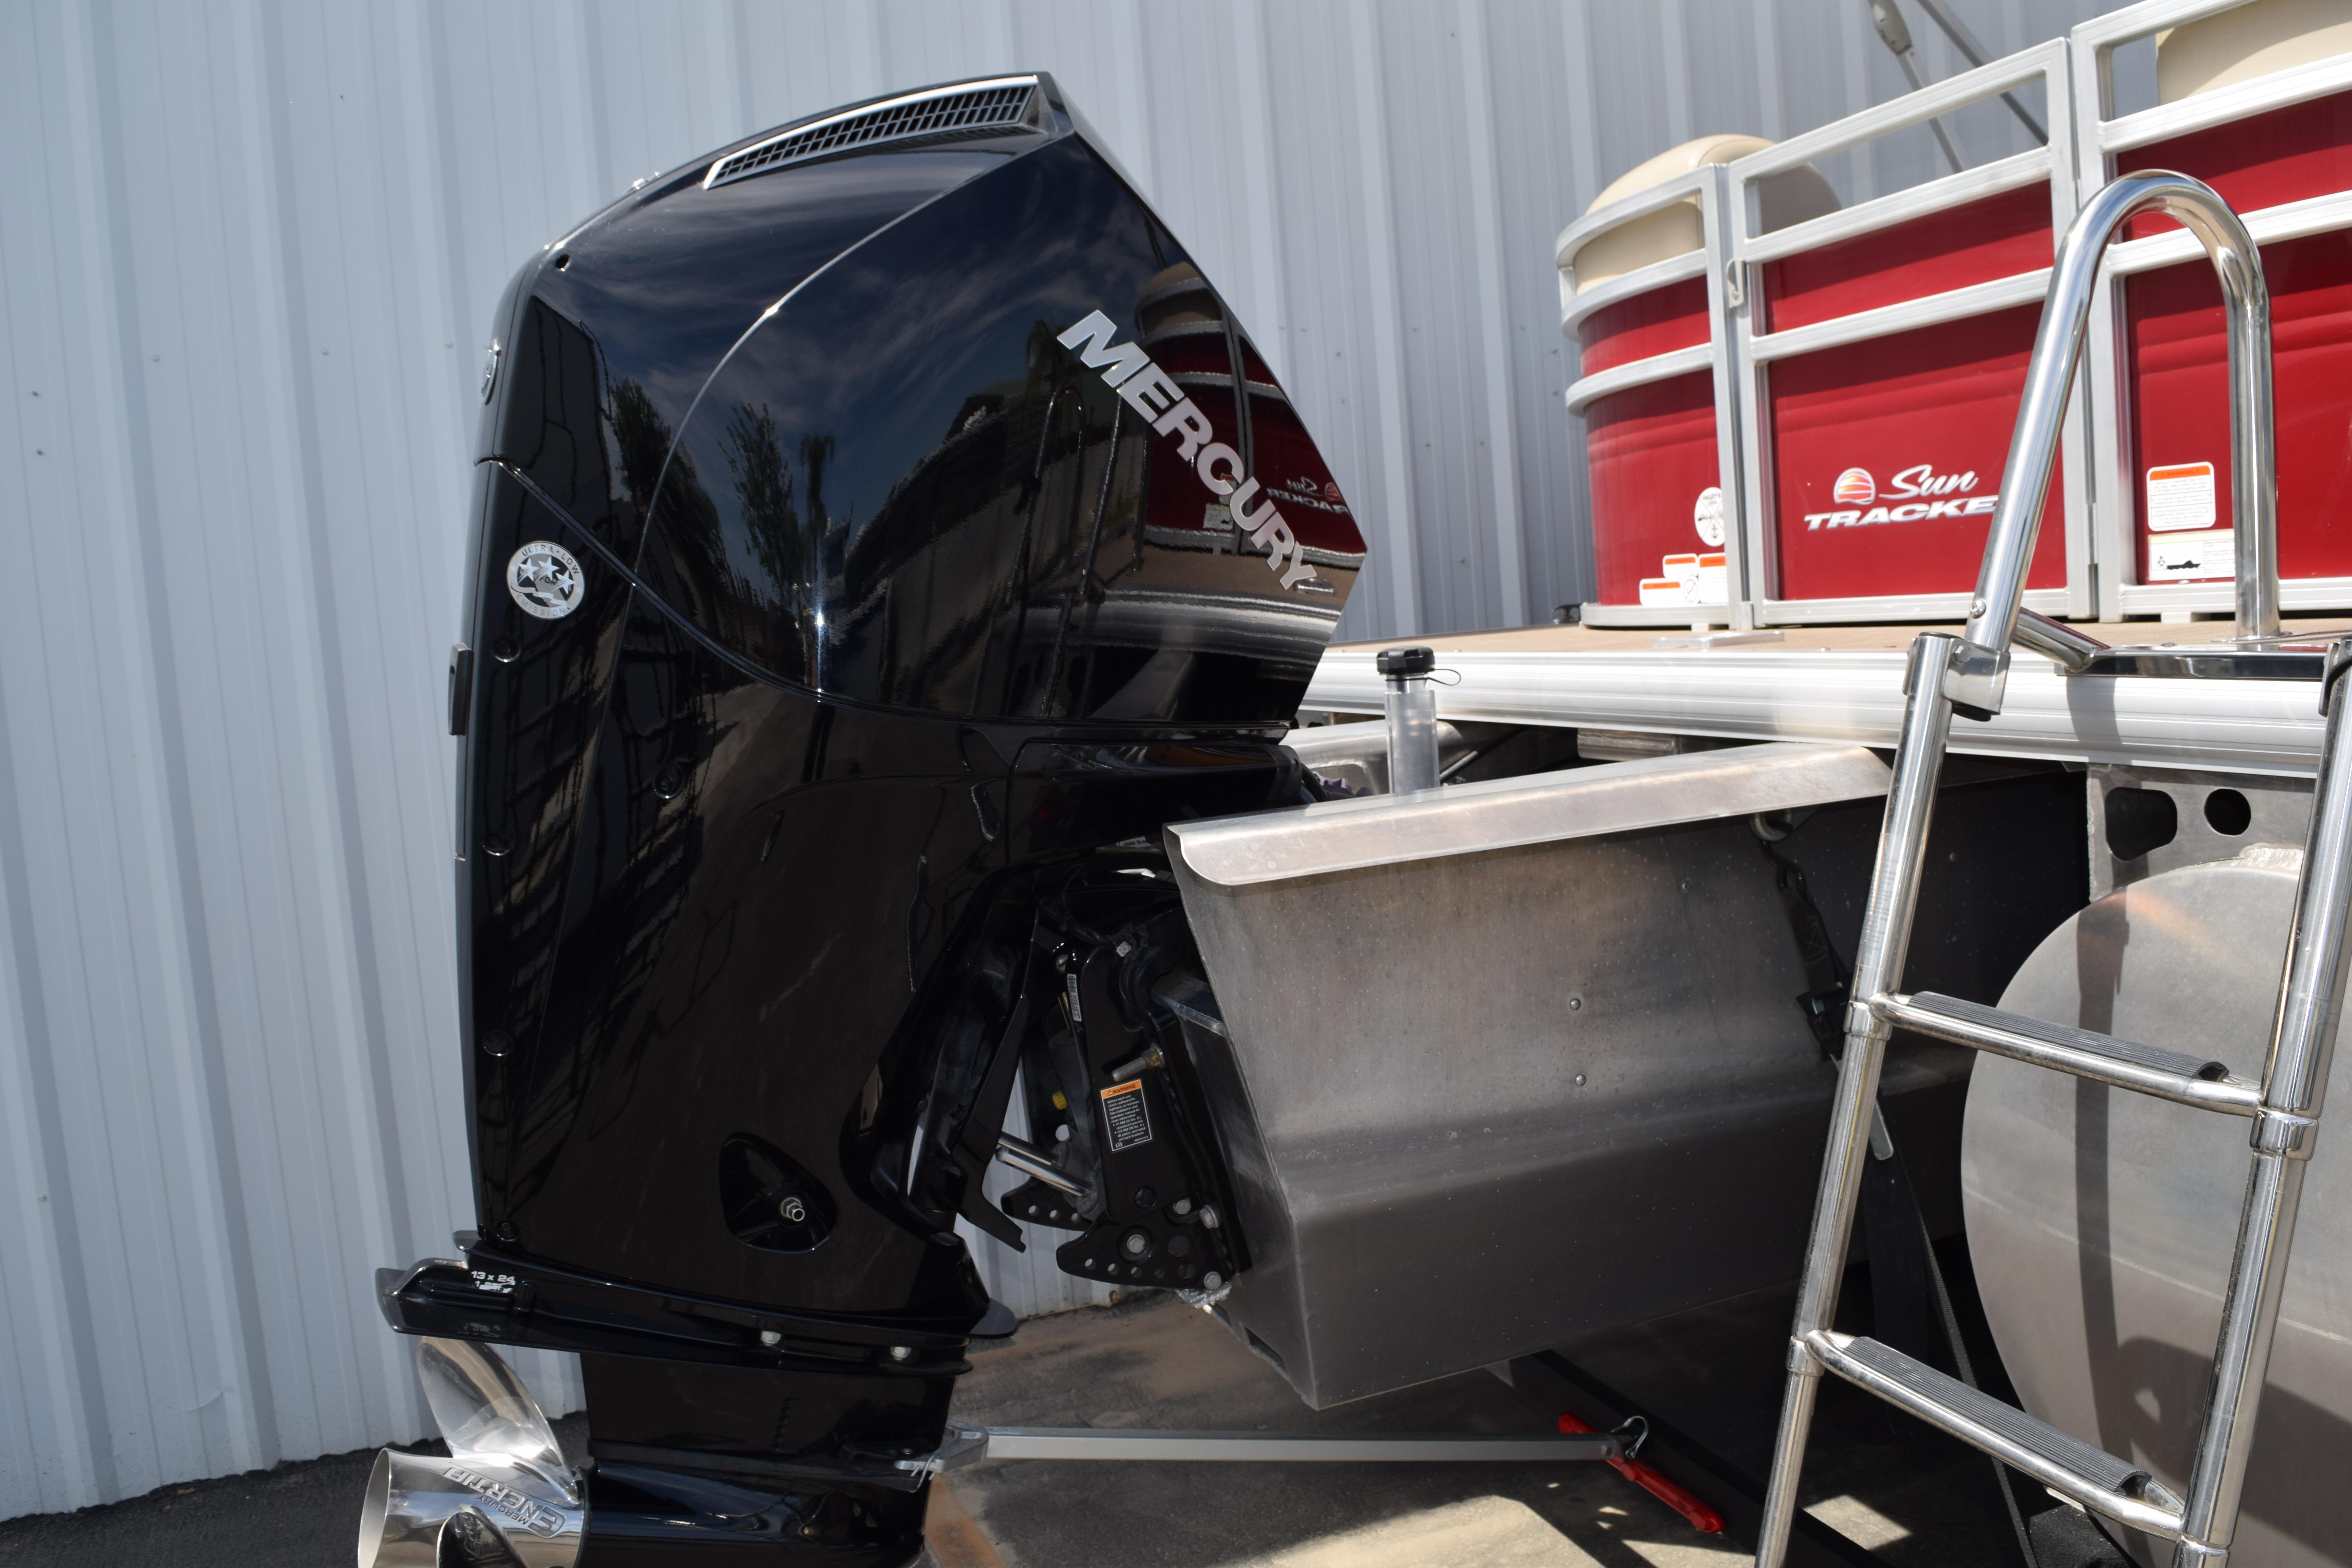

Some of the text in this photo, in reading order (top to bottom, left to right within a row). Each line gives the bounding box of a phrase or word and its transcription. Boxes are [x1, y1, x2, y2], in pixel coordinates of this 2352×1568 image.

[1056, 309, 1317, 590] MERCURY
[1879, 464, 1978, 499] Sun
[1804, 495, 1999, 532] TRACKE
[521, 544, 580, 574] ULTRA LOW
[516, 595, 565, 616] EMISSION
[1112, 1084, 1135, 1093] WARNING
[471, 1271, 486, 1280] 13
[497, 1275, 515, 1283] 24
[443, 1466, 566, 1538] ENERTIA
[476, 1495, 529, 1525] MERCURY
